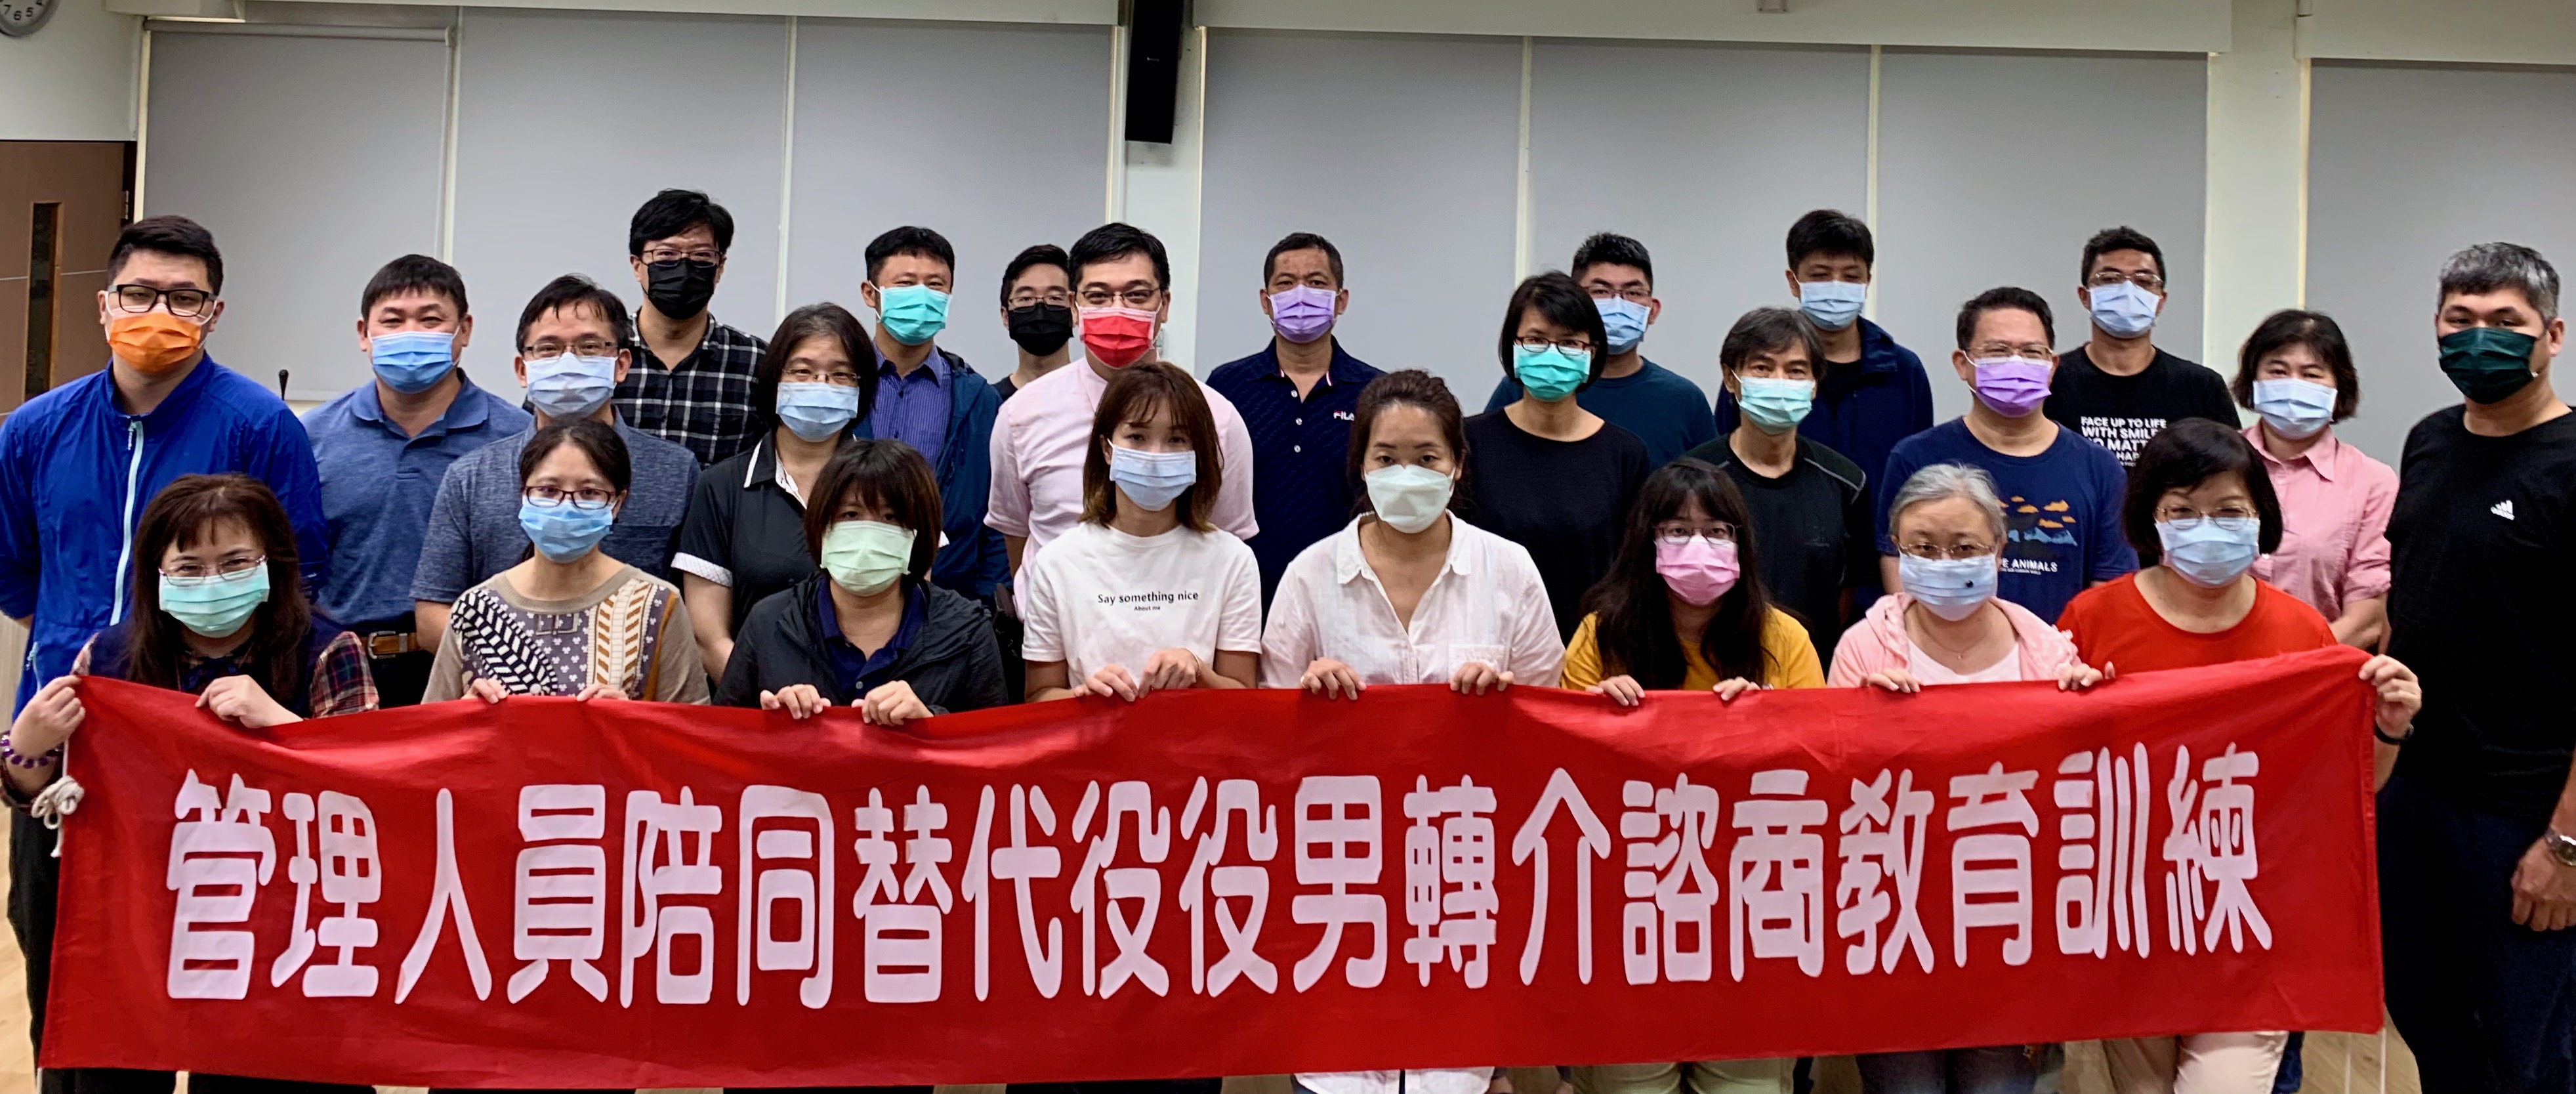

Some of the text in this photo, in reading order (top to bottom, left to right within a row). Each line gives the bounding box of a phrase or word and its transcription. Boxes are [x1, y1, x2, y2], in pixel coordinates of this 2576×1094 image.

[14, 11, 22, 20] 6
[26, 7, 33, 17] 5
[1333, 411, 1355, 421] FILA
[2080, 415, 2167, 429] FACE UP TO LIFE
[2081, 425, 2117, 438] WITH
[2012, 558, 2058, 573] ANIMALS
[1098, 590, 1199, 606] Say something nice
[166, 742, 2273, 1009] 管理人員陪同替代役役男轉介諮商教育訓練
